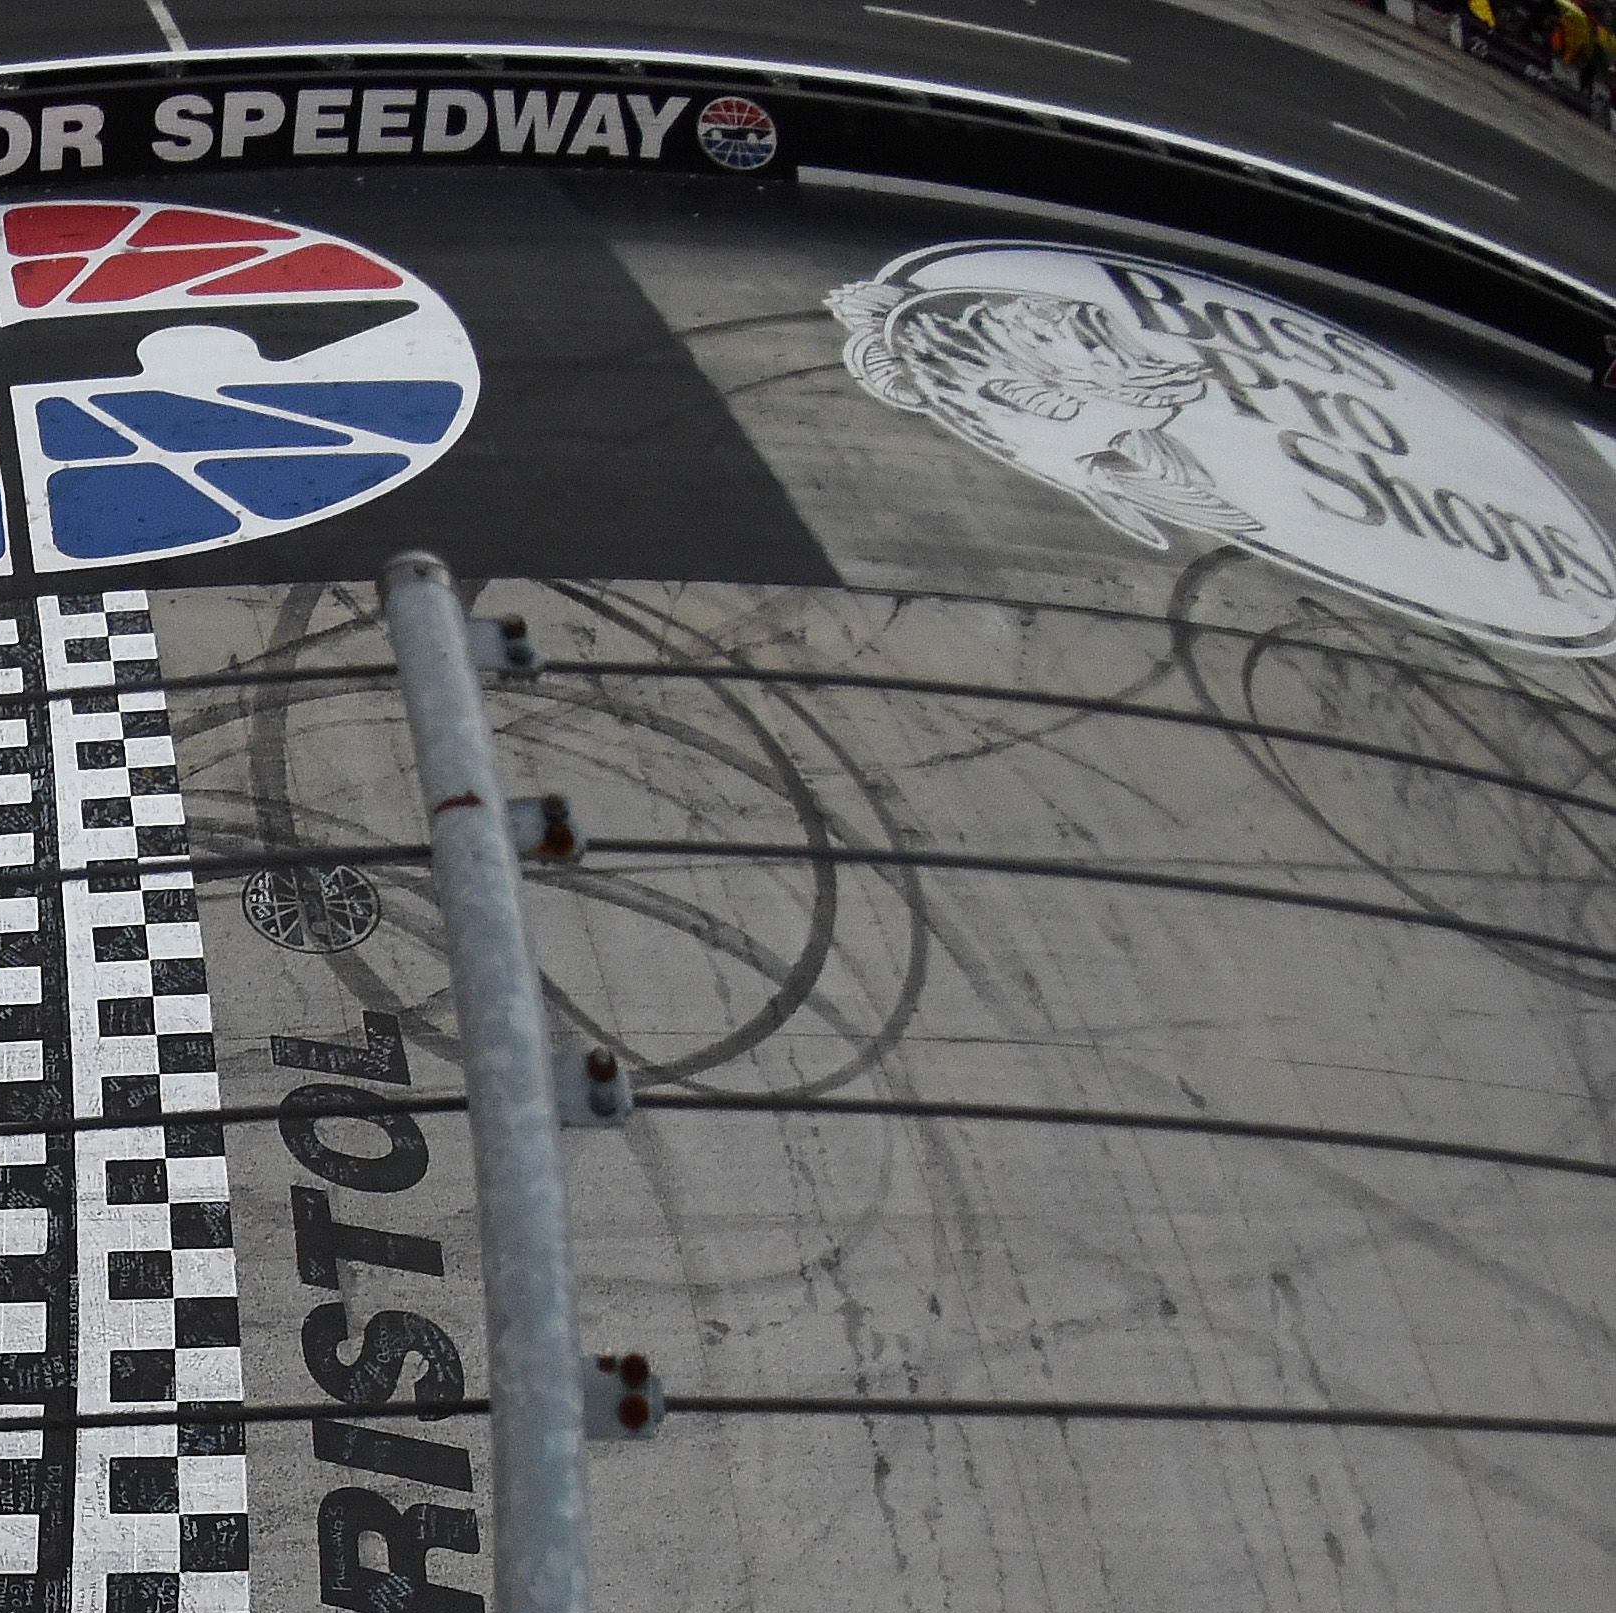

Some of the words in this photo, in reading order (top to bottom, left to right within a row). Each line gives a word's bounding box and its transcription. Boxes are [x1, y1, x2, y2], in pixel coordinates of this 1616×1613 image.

[152, 87, 690, 163] SPEEDWAY
[1095, 261, 1398, 393] Bass
[1196, 343, 1411, 458] Pro
[1277, 428, 1616, 608] Shops
